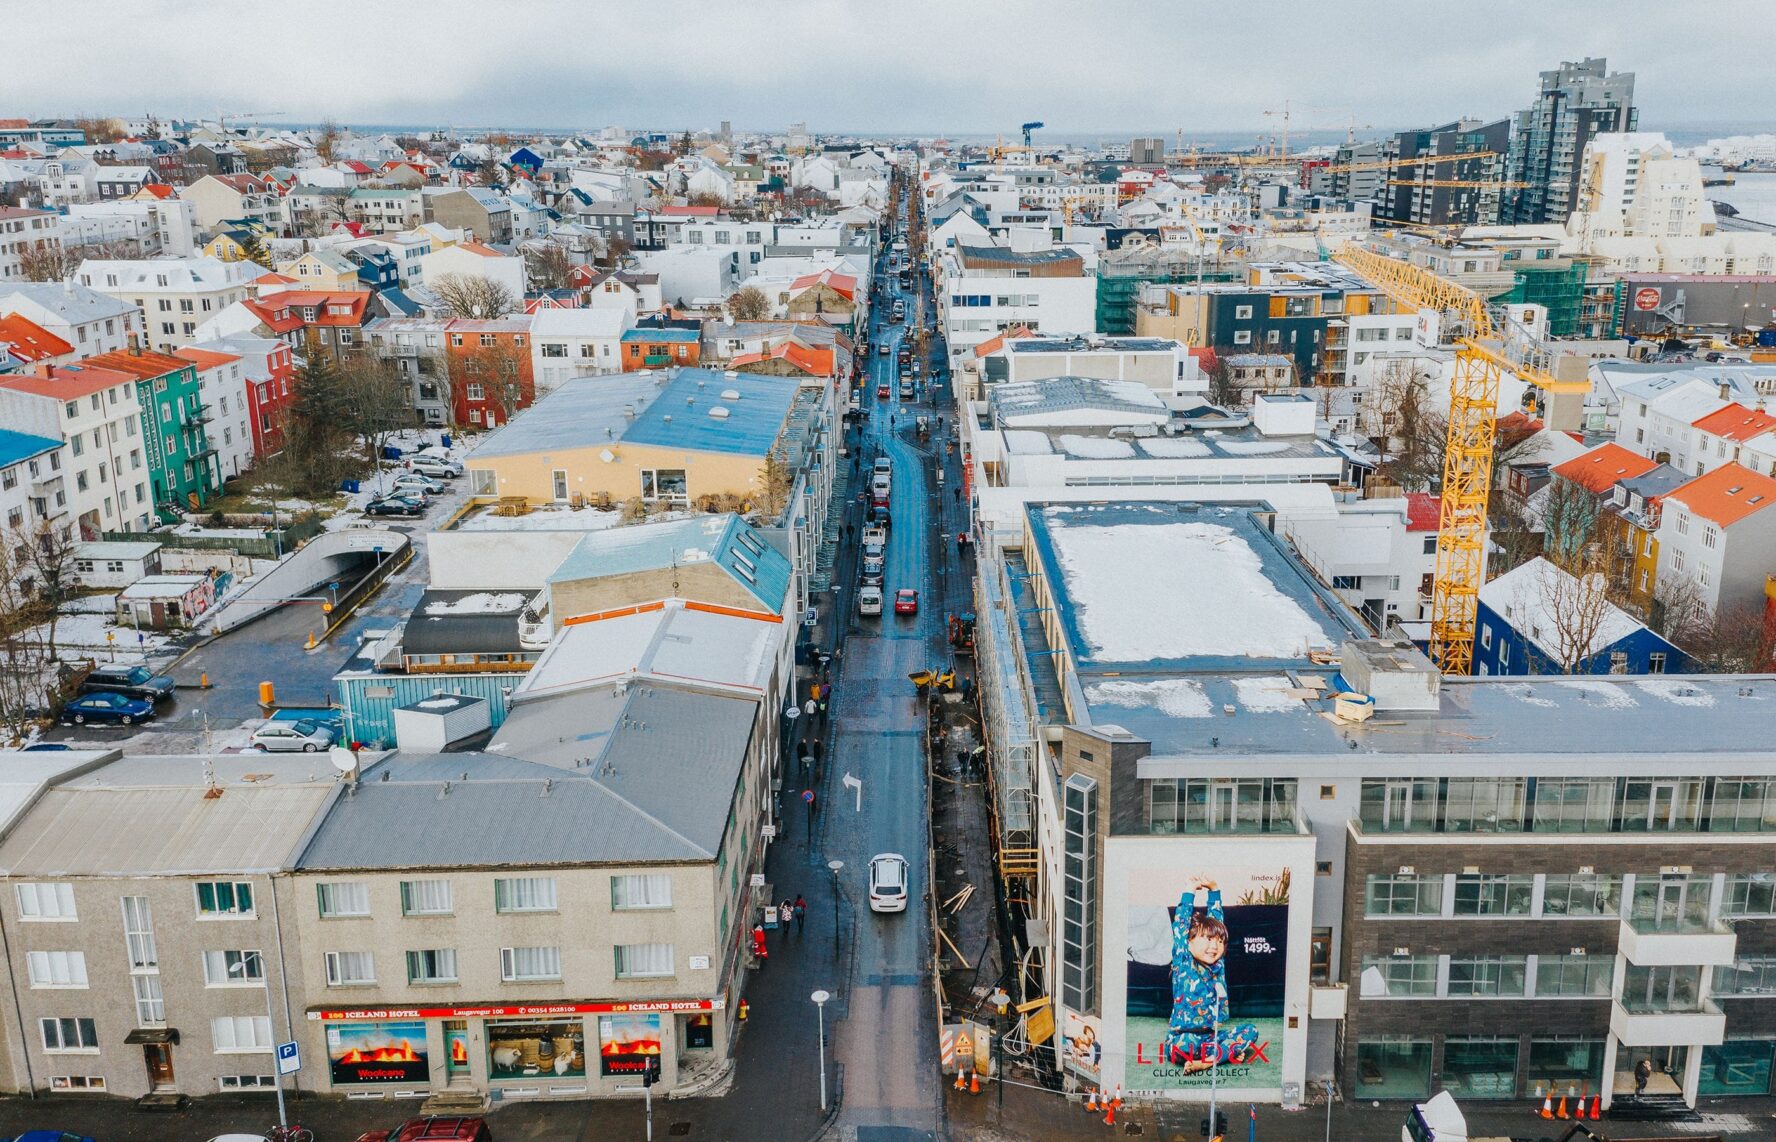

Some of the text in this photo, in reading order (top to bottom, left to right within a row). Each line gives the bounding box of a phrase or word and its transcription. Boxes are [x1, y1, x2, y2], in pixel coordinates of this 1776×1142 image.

[1251, 874, 1281, 882] lindex.is
[1243, 943, 1277, 954] 1499,-
[283, 1046, 292, 1057] P
[1137, 1041, 1270, 1065] LINDEX
[357, 1068, 406, 1077] Woolcano
[1152, 1068, 1181, 1077] CLICK
